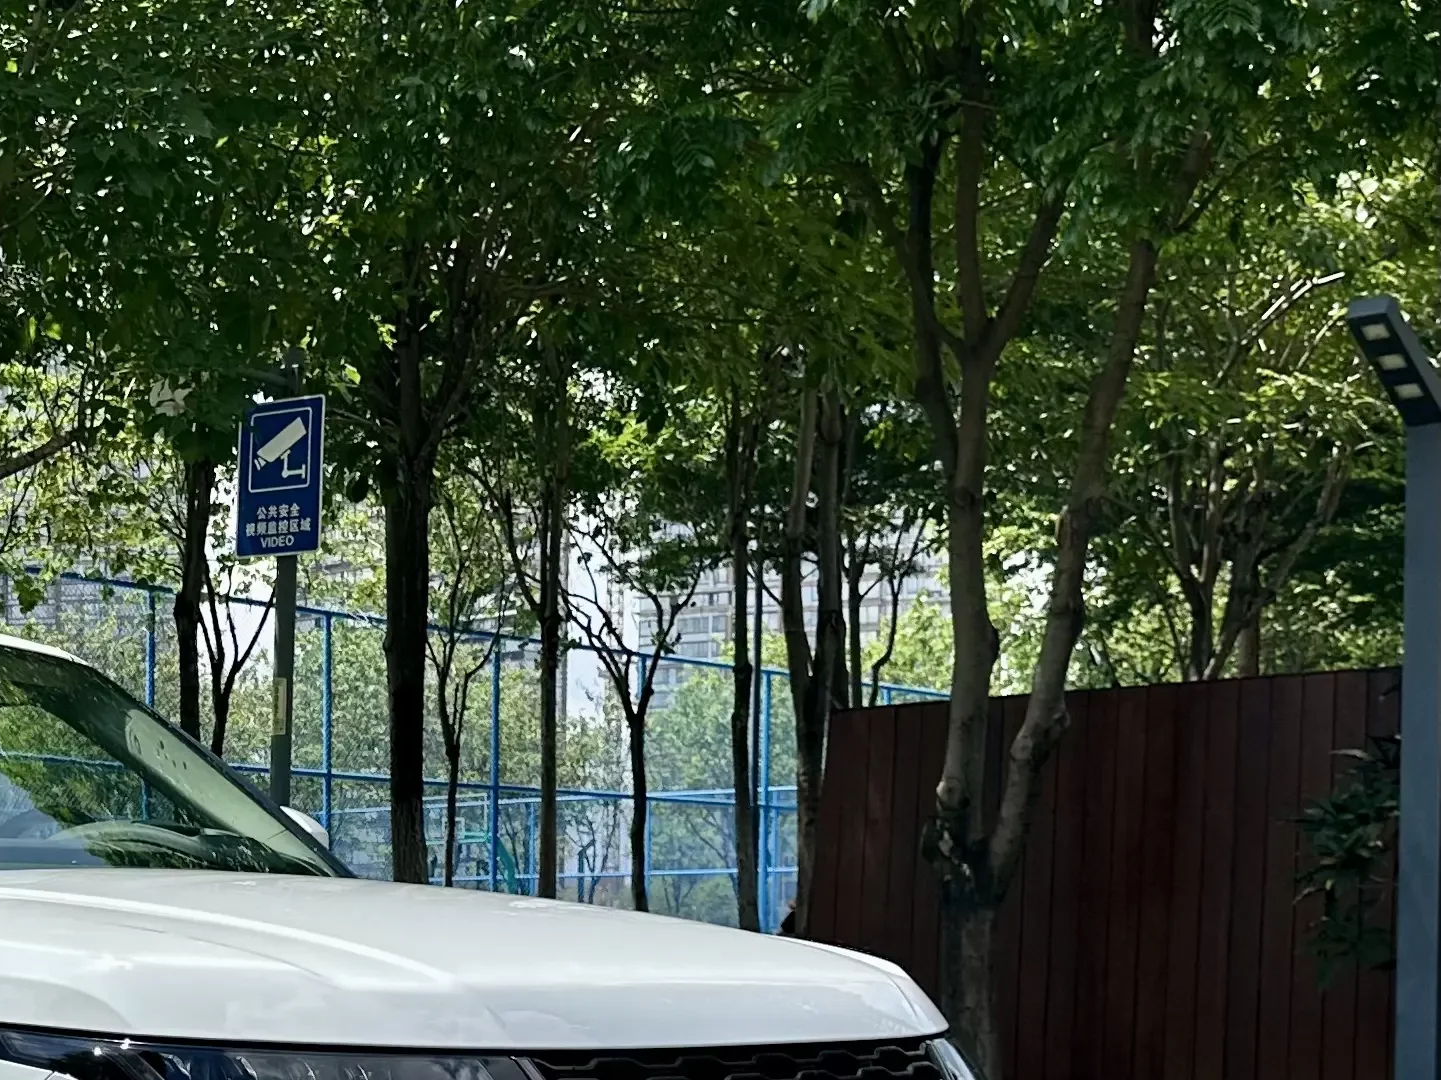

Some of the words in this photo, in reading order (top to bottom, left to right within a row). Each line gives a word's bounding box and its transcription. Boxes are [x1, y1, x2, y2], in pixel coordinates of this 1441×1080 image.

[256, 502, 300, 520] 公共安全
[245, 517, 311, 537] 视频监控区域
[260, 534, 295, 548] VIDEO
